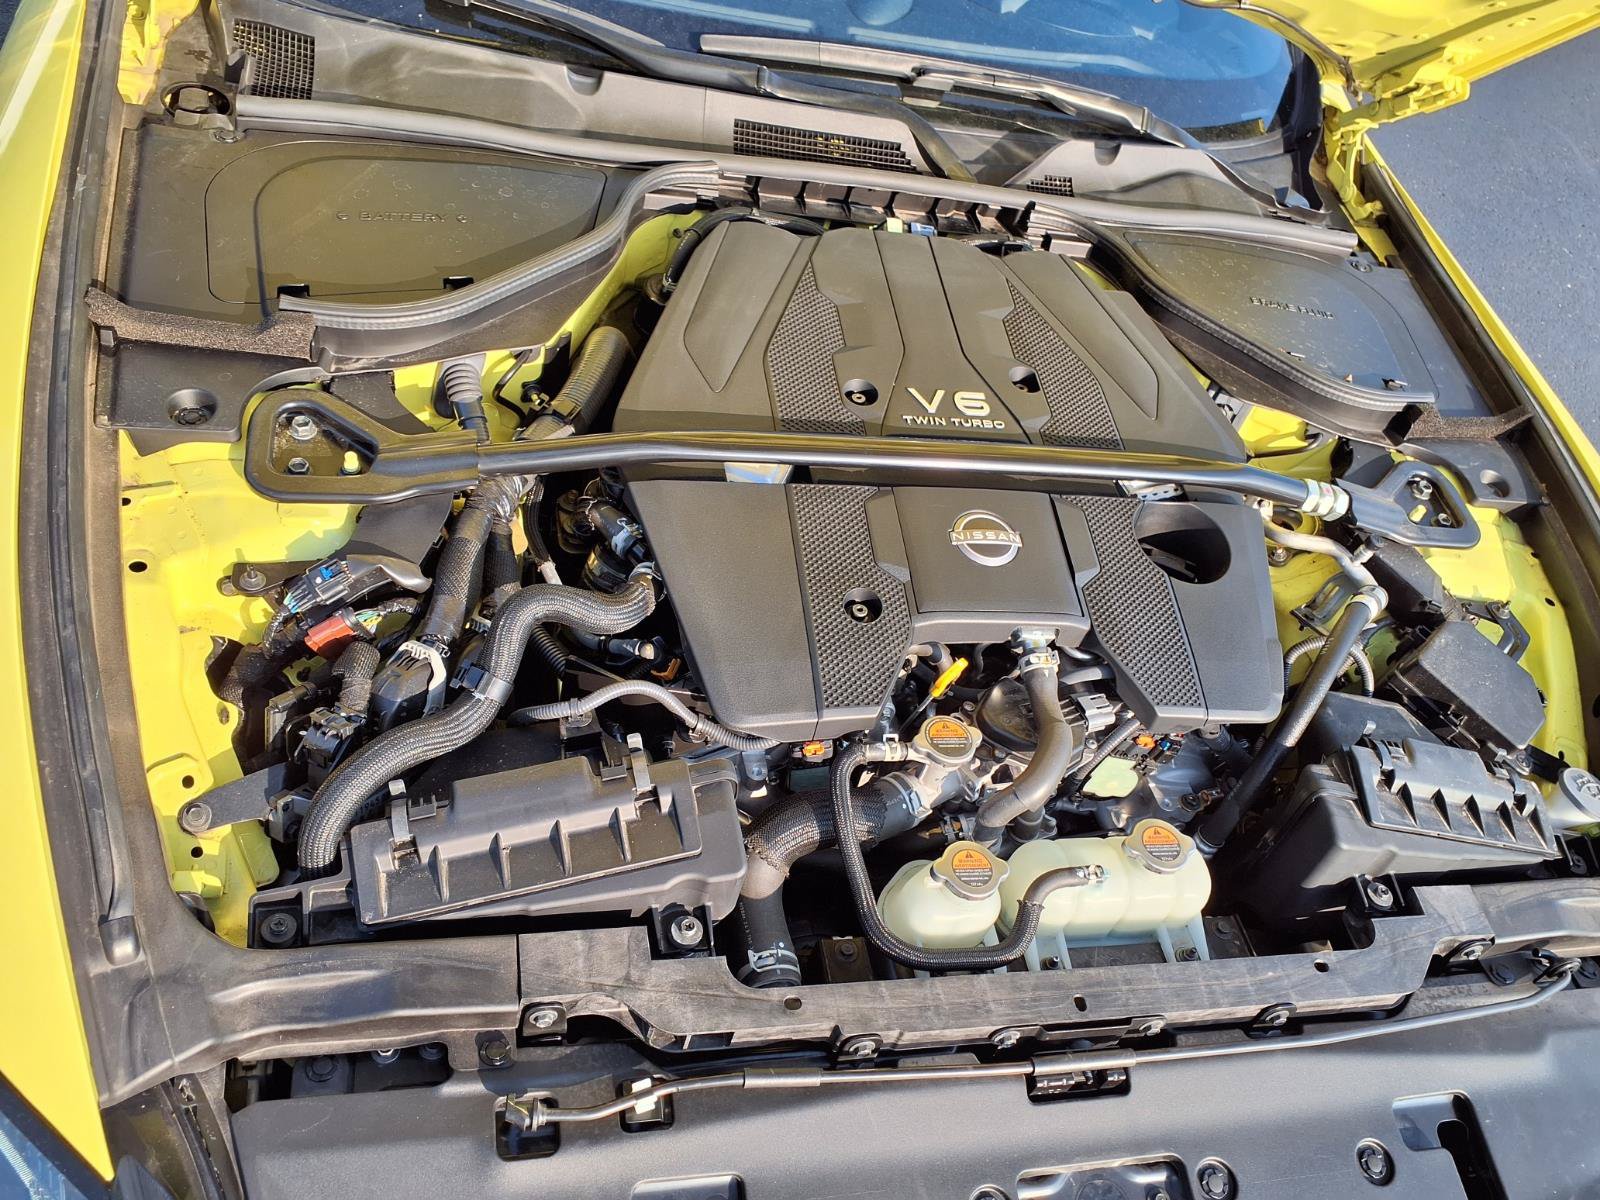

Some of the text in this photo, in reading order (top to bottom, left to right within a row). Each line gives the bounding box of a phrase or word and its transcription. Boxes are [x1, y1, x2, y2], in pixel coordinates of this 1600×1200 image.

[359, 211, 448, 222] BATTERY
[906, 387, 990, 416] V6
[902, 415, 1006, 429] TWIN TURBO
[952, 531, 1020, 542] NISSAN
